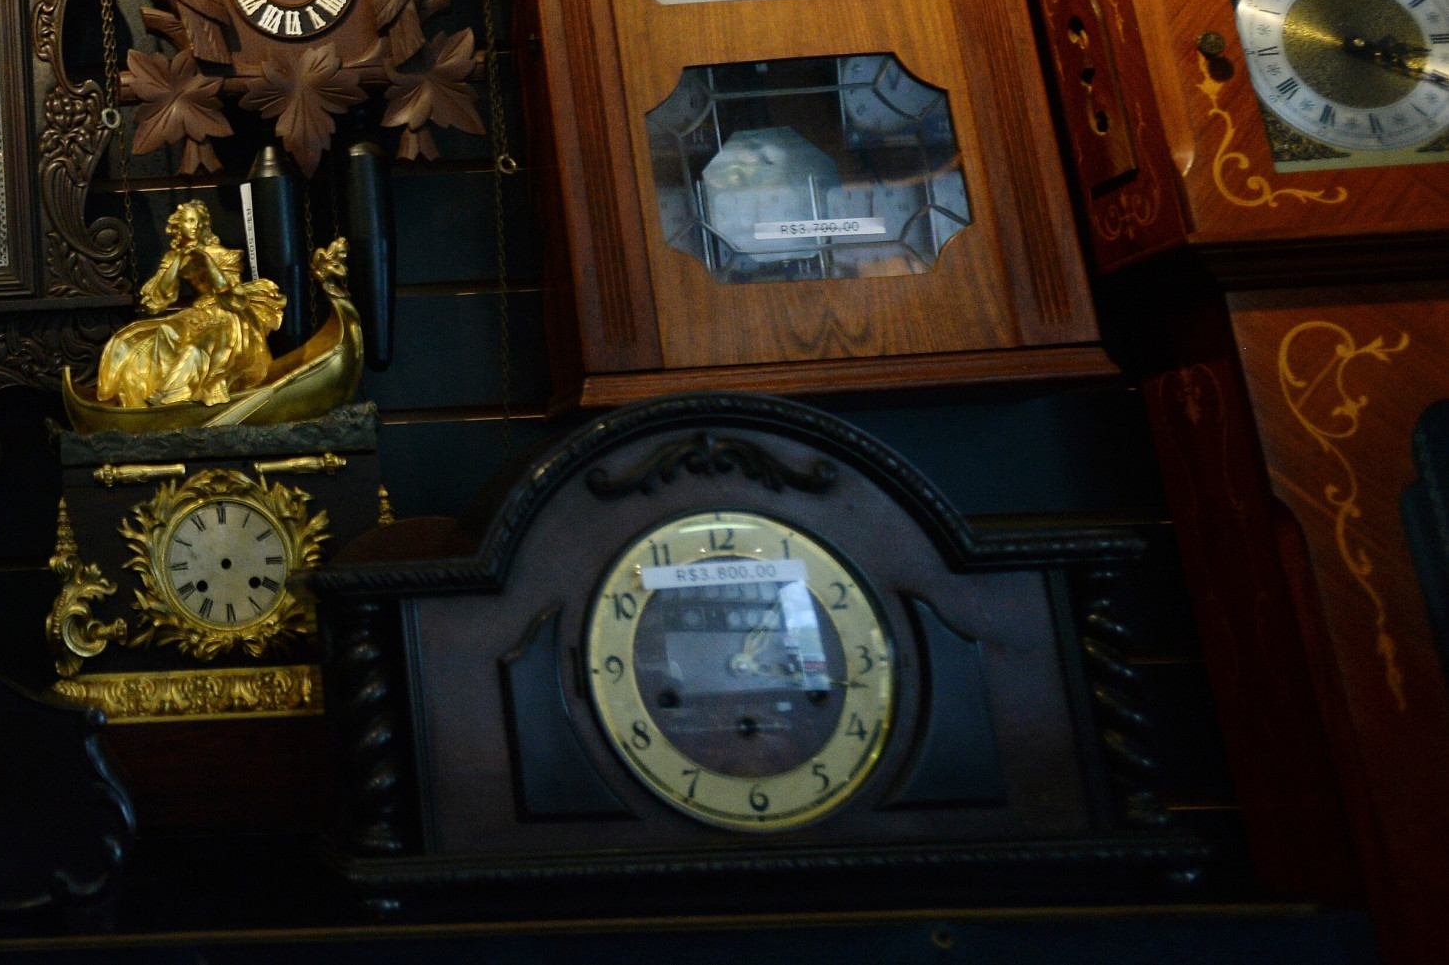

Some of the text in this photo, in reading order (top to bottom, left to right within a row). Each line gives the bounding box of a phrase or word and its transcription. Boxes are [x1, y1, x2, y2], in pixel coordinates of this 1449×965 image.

[652, 540, 671, 566] 11
[709, 528, 735, 551] 12
[781, 538, 791, 559] 1
[612, 593, 636, 620] 10
[829, 581, 850, 609] 2
[605, 655, 624, 683] 9
[854, 645, 872, 674] 3
[631, 720, 651, 750] 8
[844, 711, 867, 739] 4
[682, 769, 699, 798] 7
[812, 764, 829, 790] 5
[750, 791, 768, 811] 6
